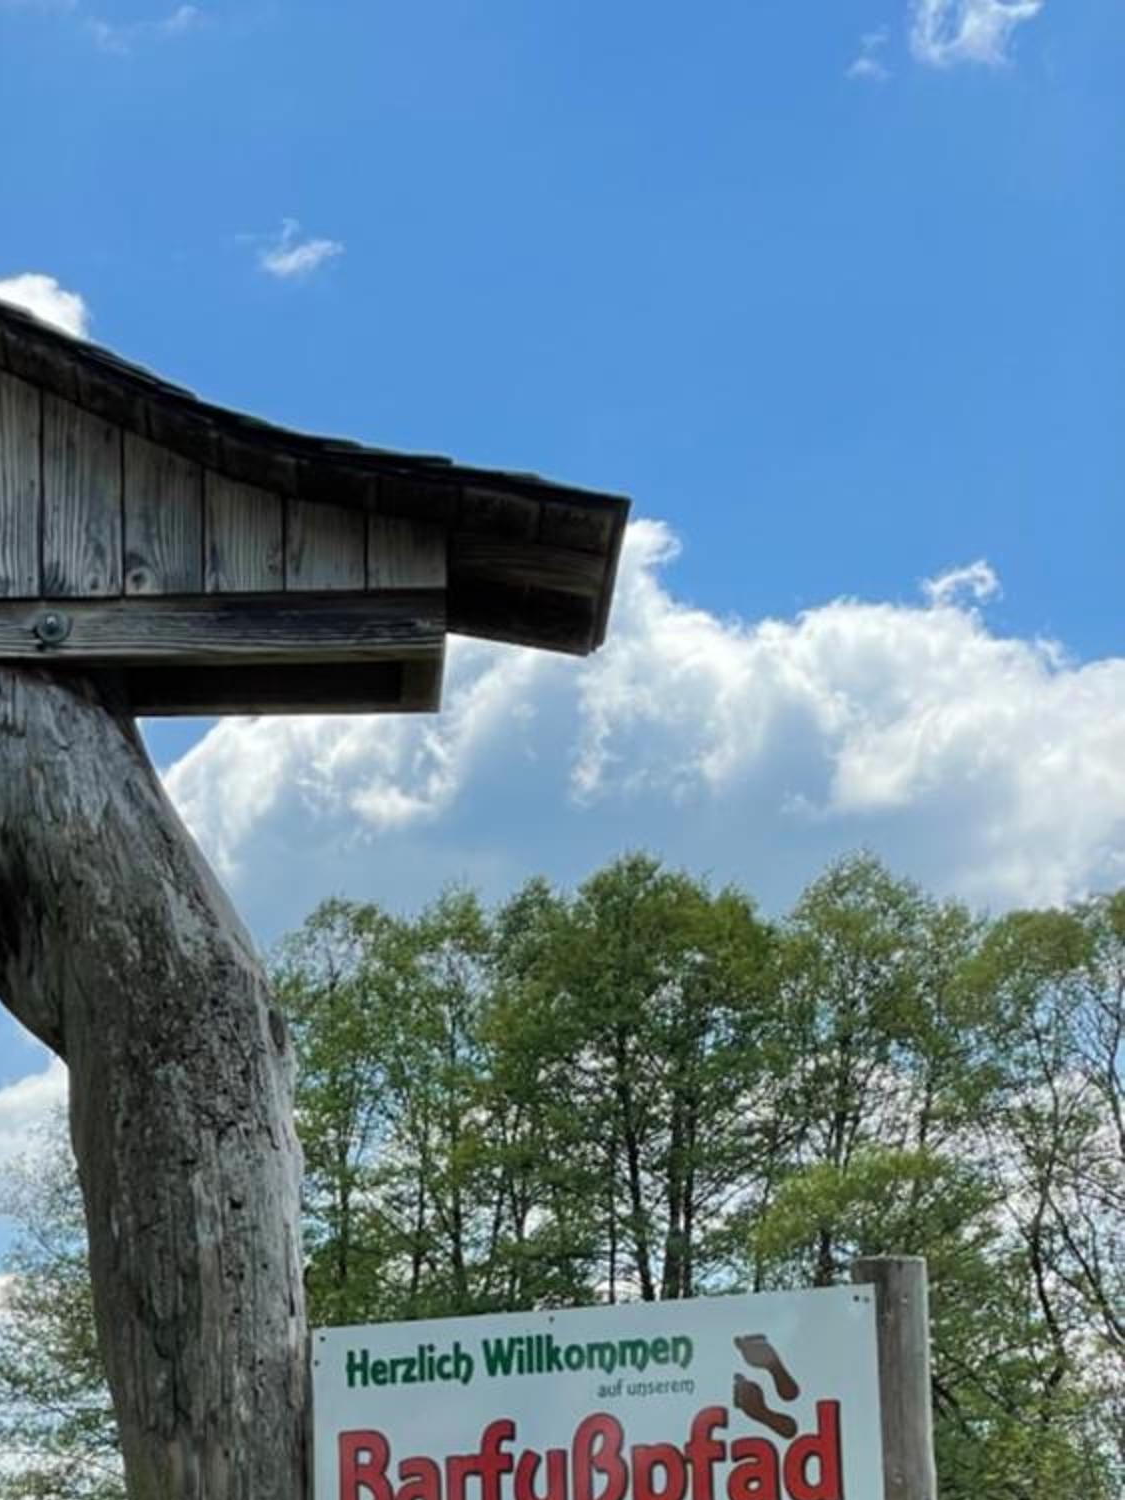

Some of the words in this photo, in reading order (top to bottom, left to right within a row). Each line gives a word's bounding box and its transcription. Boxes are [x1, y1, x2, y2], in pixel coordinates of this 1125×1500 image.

[346, 1338, 475, 1388] Herzlich
[481, 1333, 695, 1378] Willkommen
[598, 1383, 622, 1398] auf
[626, 1379, 695, 1396] unserem
